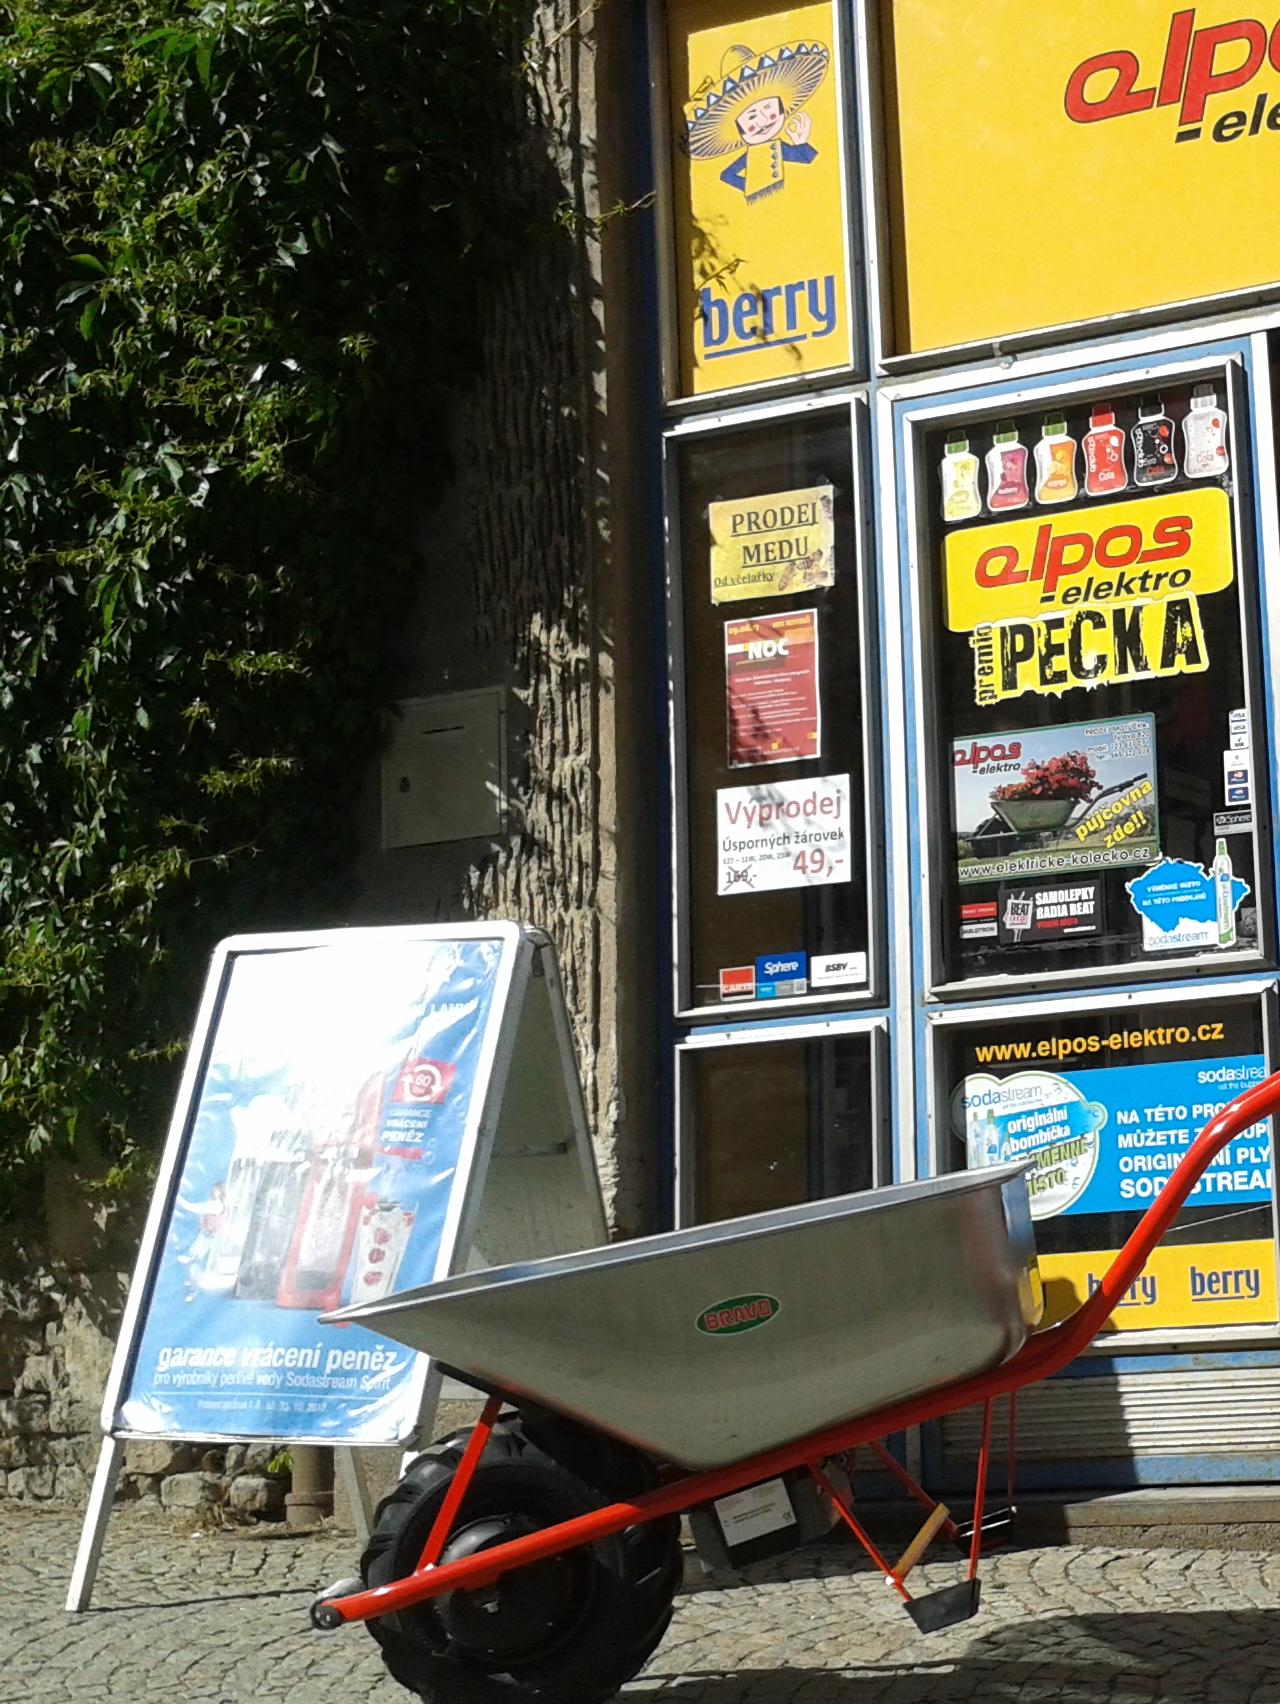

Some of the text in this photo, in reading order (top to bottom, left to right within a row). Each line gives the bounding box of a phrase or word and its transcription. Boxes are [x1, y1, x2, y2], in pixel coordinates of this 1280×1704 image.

[702, 272, 837, 341] berry
[731, 501, 818, 534] PRODEJ
[741, 536, 809, 565] MEDU
[1000, 594, 1202, 691] PECKA
[724, 789, 842, 829] Výprodej
[722, 827, 845, 853] Úsporných žárovek
[1103, 809, 1147, 849] zde!!
[792, 848, 844, 878] 49,-
[1034, 886, 1096, 906] SAMOLEPKY
[1036, 900, 1096, 920] RADIA BEAT
[763, 960, 799, 976] Sphere
[975, 1022, 1225, 1063] www.elpos-elektro.cz
[414, 1073, 432, 1086] 60
[1197, 1064, 1266, 1084] sodastrea
[962, 1086, 1043, 1110] sodastream
[1007, 1105, 1069, 1135] originální
[1116, 1109, 1140, 1125] NA
[1144, 1104, 1187, 1122] TÉTO
[1009, 1125, 1071, 1153] bombička
[1117, 1128, 1190, 1149] MŮŽETE
[1119, 1146, 1271, 1173] ORIGINNÍ PLY
[1025, 1167, 1067, 1197] ÍSTO
[1120, 1169, 1272, 1199] SODSTREA
[1190, 1264, 1260, 1299] berry
[704, 1299, 772, 1332] BRAVO
[325, 1345, 399, 1375] peněz
[285, 1371, 358, 1390] Sodastream
